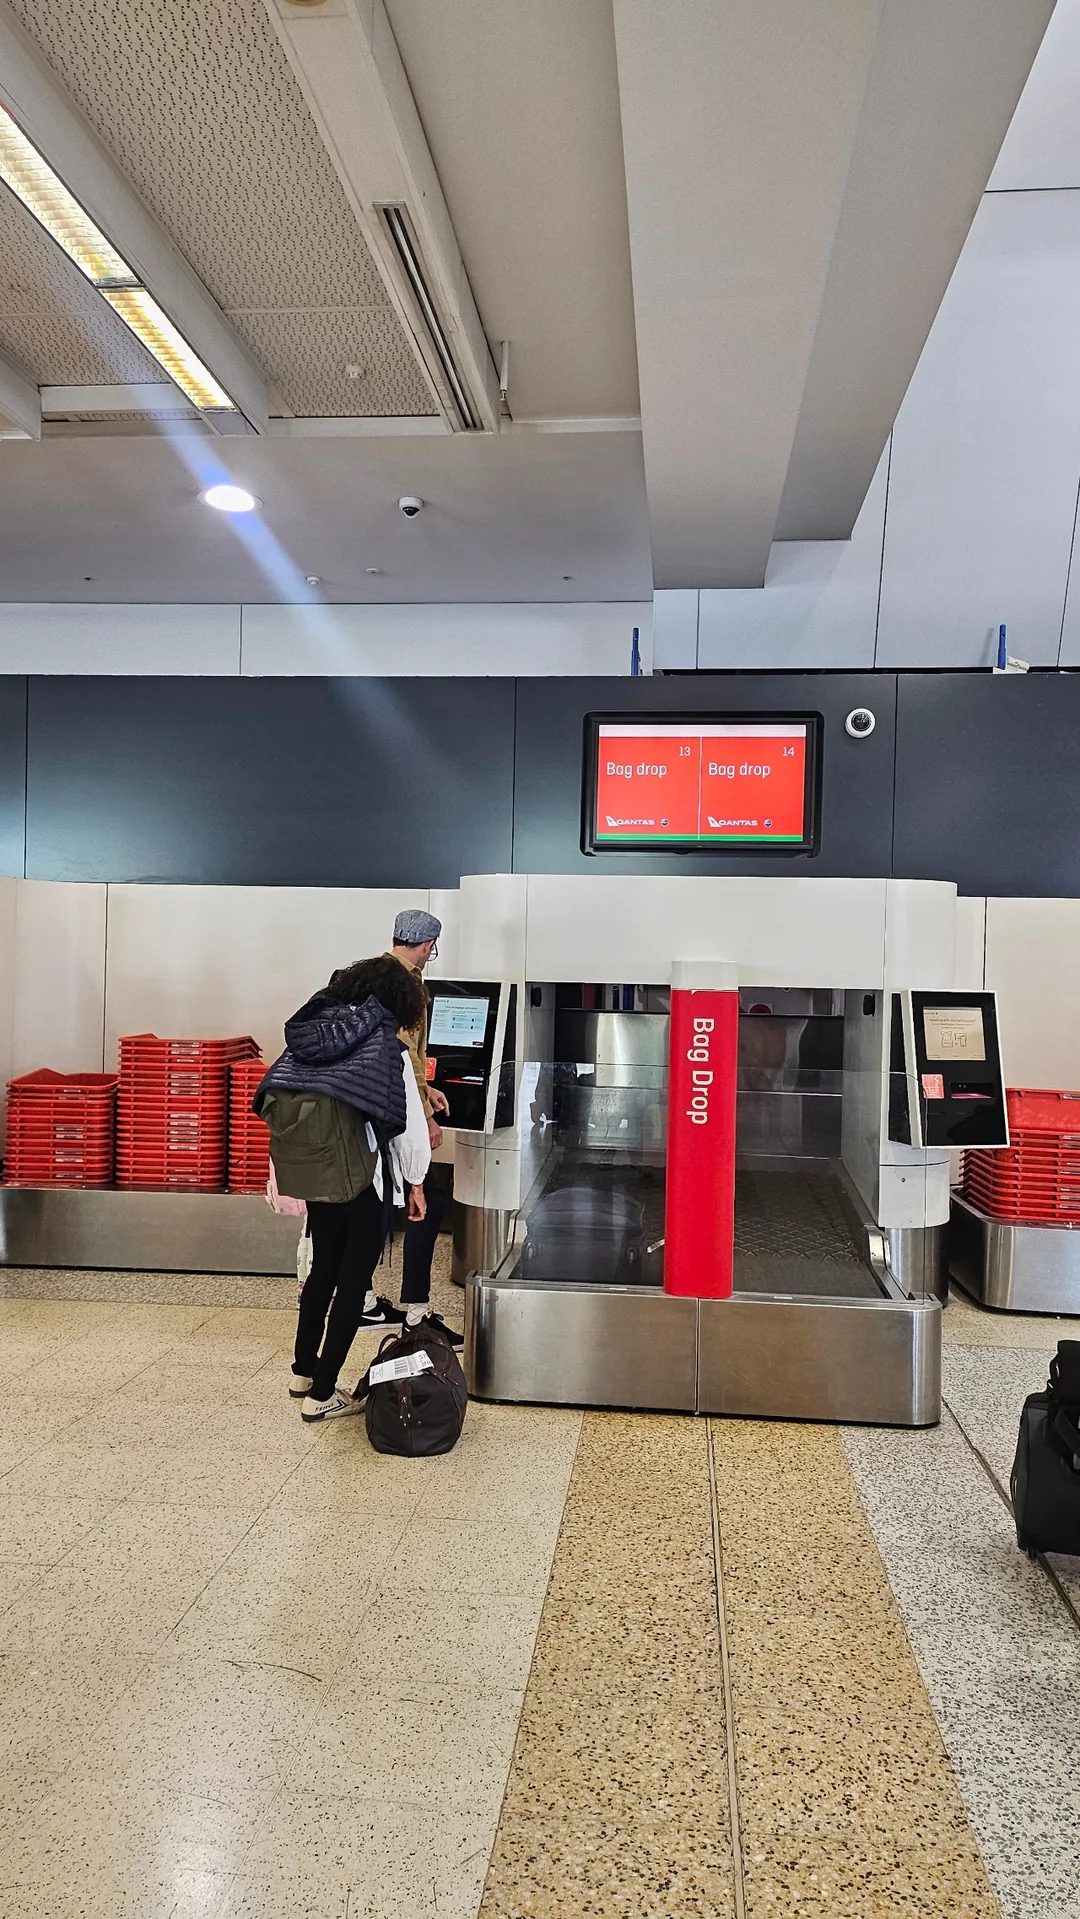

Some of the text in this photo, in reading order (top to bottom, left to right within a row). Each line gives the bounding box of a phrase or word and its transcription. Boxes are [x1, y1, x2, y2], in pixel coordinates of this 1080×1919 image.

[678, 746, 691, 757] 13
[782, 746, 795, 757] 14
[606, 762, 667, 778] Bag drop
[708, 762, 771, 779] Bag drop
[718, 819, 758, 827] QANTAS
[686, 1018, 715, 1125] Bag Drop
